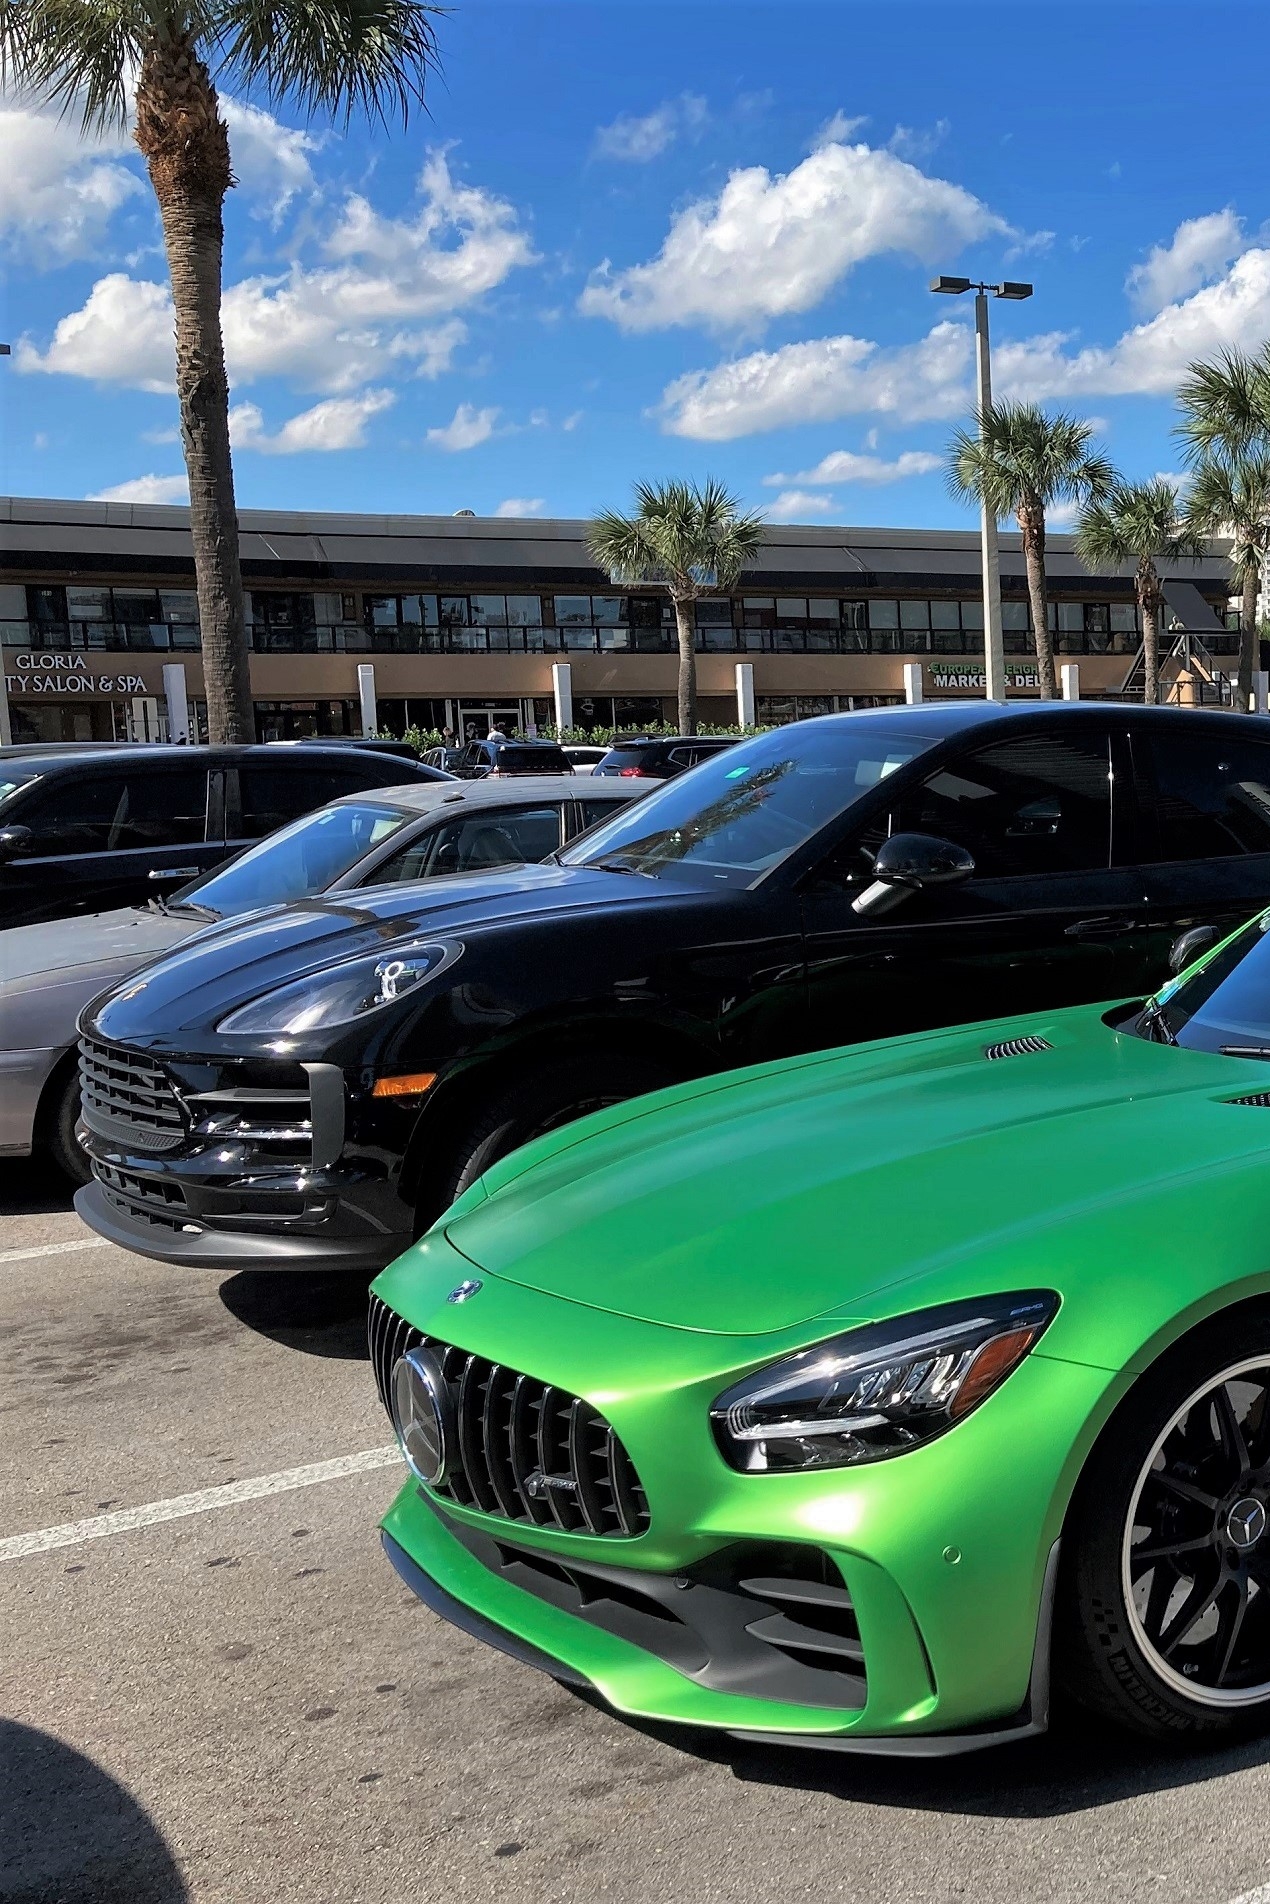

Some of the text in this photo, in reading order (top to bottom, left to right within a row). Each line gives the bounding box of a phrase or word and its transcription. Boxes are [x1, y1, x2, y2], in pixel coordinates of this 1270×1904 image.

[16, 655, 86, 669] GLORIA
[928, 662, 986, 675] EUROPEA
[5, 675, 148, 692] TY SALON & SPA
[936, 675, 987, 687] MARKE
[1015, 675, 1041, 687] DEL
